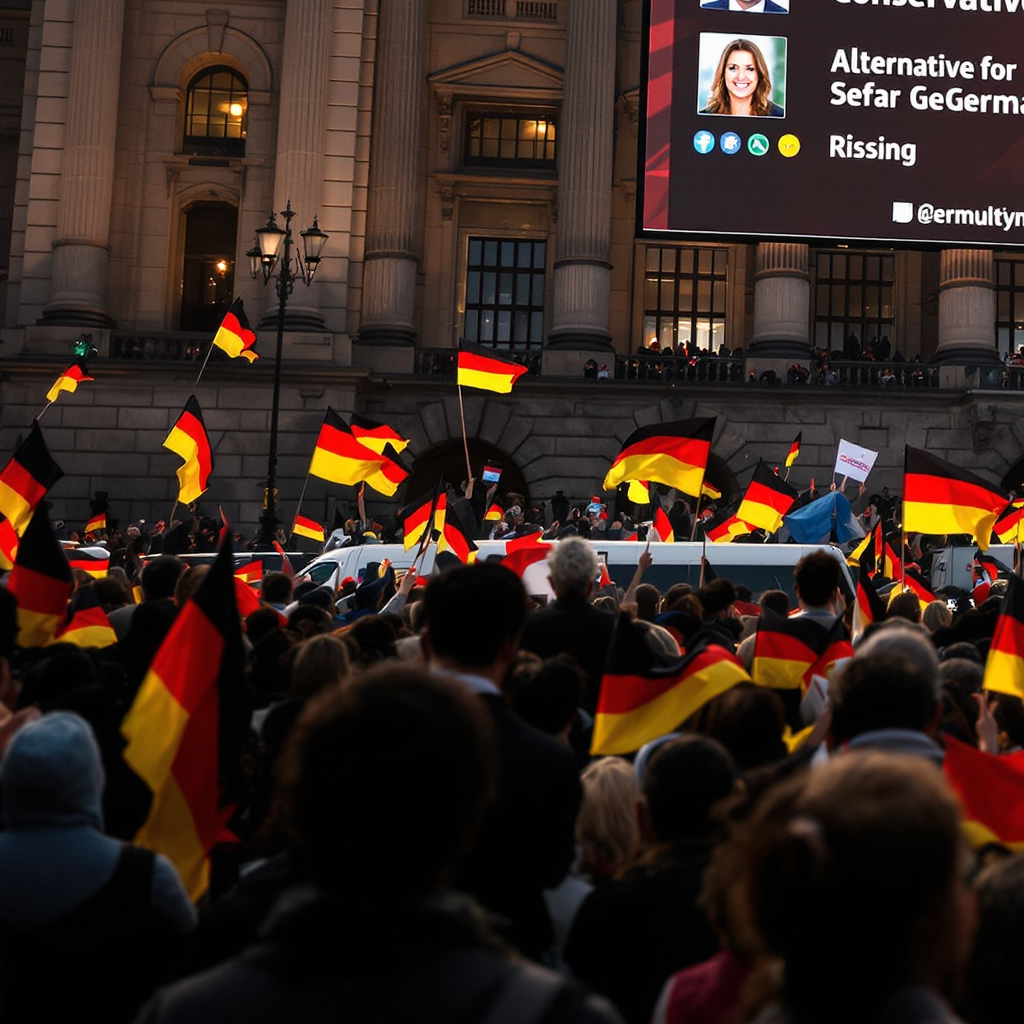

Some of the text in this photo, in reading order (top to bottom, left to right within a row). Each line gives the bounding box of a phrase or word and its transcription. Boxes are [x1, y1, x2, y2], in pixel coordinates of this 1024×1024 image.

[830, 46, 1018, 82] Alternative for
[829, 81, 902, 109] Sefar
[829, 134, 917, 167] Rissing
